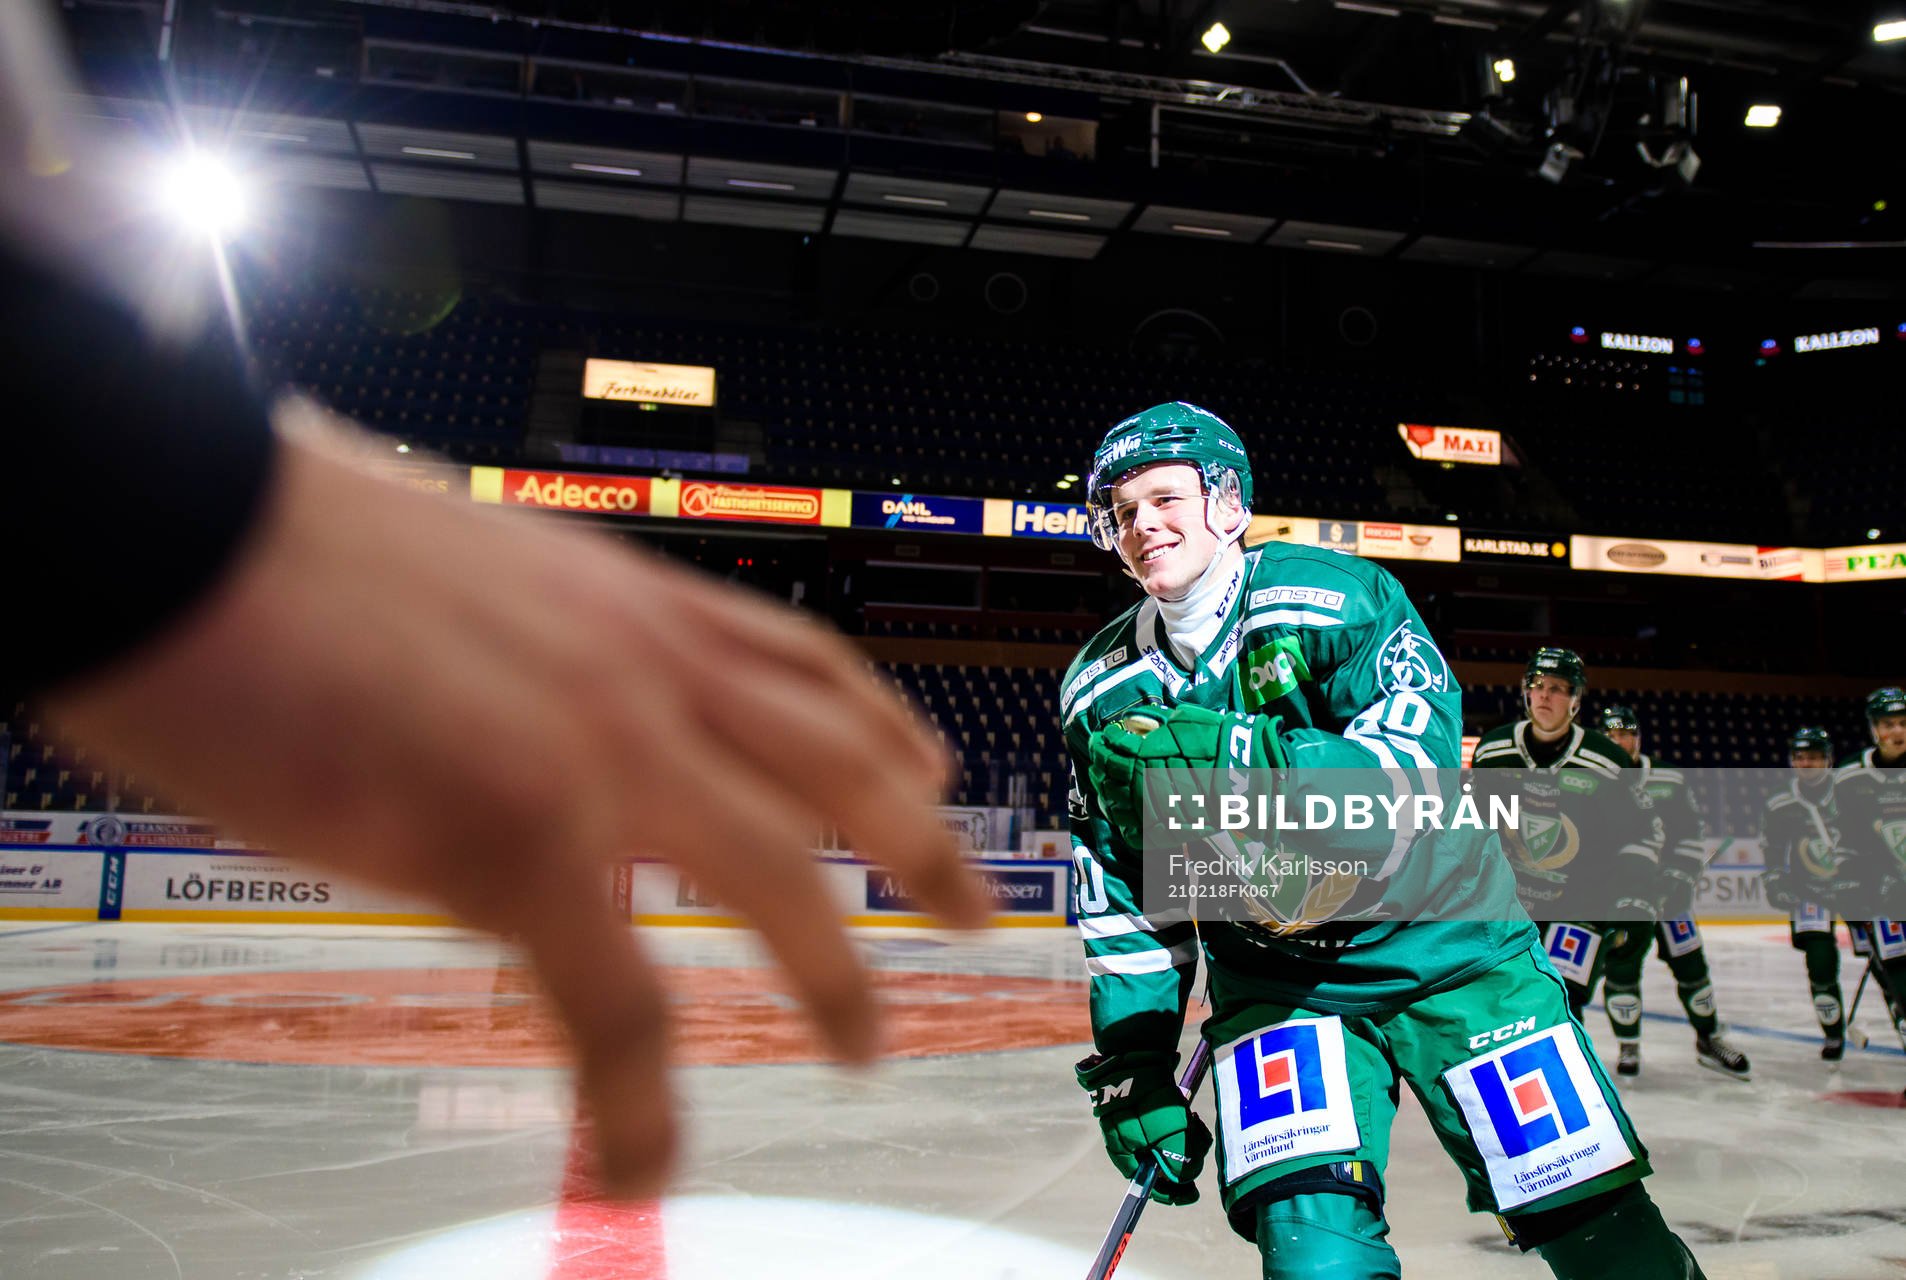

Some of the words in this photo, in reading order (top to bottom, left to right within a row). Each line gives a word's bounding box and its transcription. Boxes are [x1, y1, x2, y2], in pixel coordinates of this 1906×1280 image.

[1601, 332, 1674, 354] KALLZON
[1795, 328, 1880, 352] KALLZON
[1218, 438, 1245, 456] CCM
[515, 475, 638, 511] Adecco
[882, 500, 932, 516] DAHL
[1465, 538, 1550, 557] KARLSTAD.SE
[1214, 570, 1240, 619] CCM
[106, 856, 119, 906] CCM
[166, 872, 330, 903] LÖFBERGS
[1469, 1016, 1537, 1050] CCM
[1243, 1123, 1331, 1154] Länsförsäkringar
[1162, 1149, 1192, 1163] CCM
[1244, 1140, 1295, 1165] Värmland
[1513, 1142, 1601, 1185] Länsförsäkringar
[1517, 1168, 1573, 1195] Värmland
